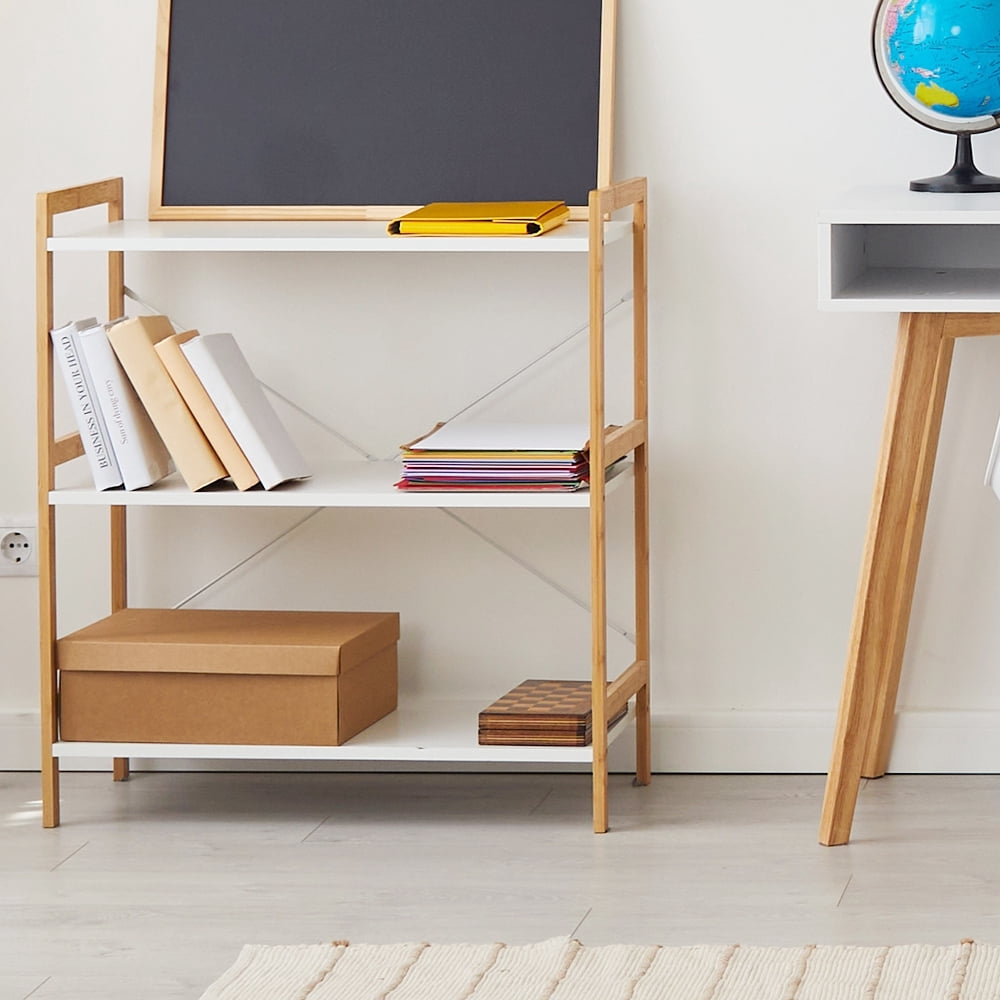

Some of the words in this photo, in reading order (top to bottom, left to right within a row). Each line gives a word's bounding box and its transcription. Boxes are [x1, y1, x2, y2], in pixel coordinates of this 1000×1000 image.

[61, 336, 77, 368] HEAD
[71, 369, 88, 402] YOUR
[82, 402, 92, 415] IN
[88, 416, 108, 468] BUSINESS
